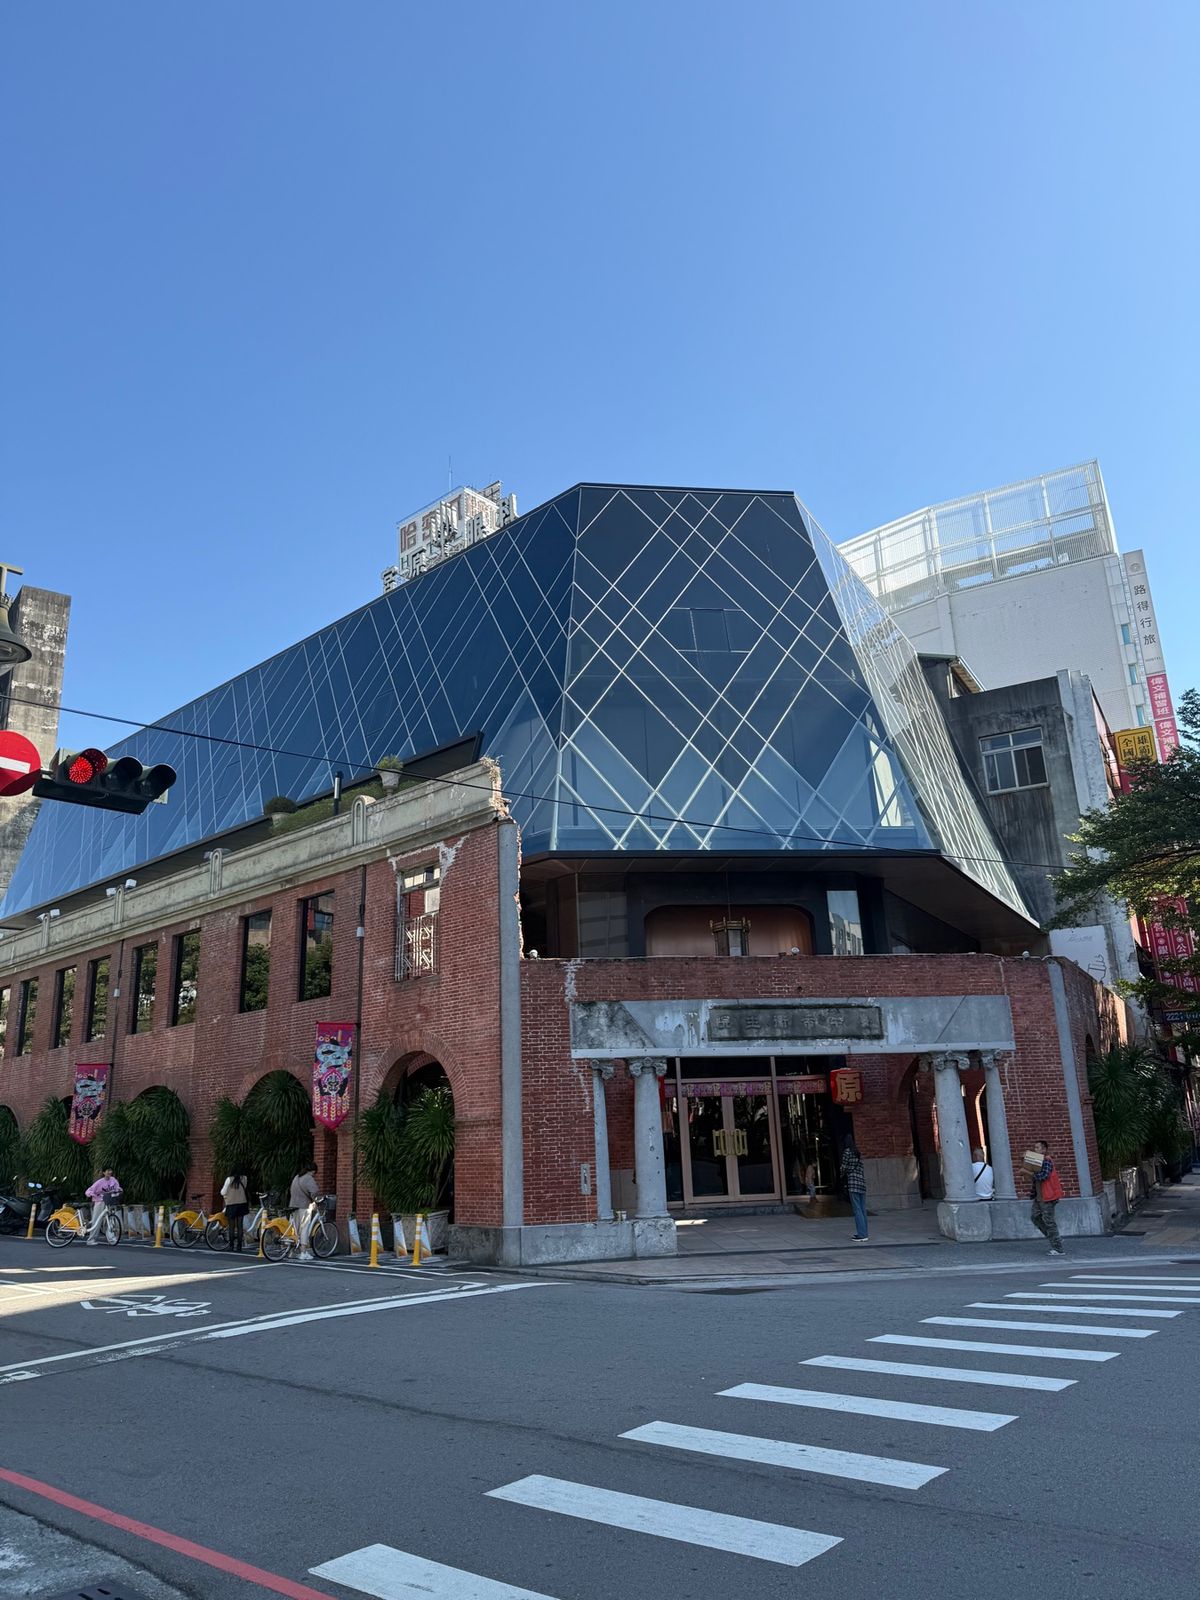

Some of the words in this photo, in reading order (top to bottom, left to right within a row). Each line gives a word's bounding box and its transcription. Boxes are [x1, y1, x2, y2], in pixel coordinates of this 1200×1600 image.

[1134, 584, 1156, 645] 路得行旅
[836, 1072, 862, 1102] 原
